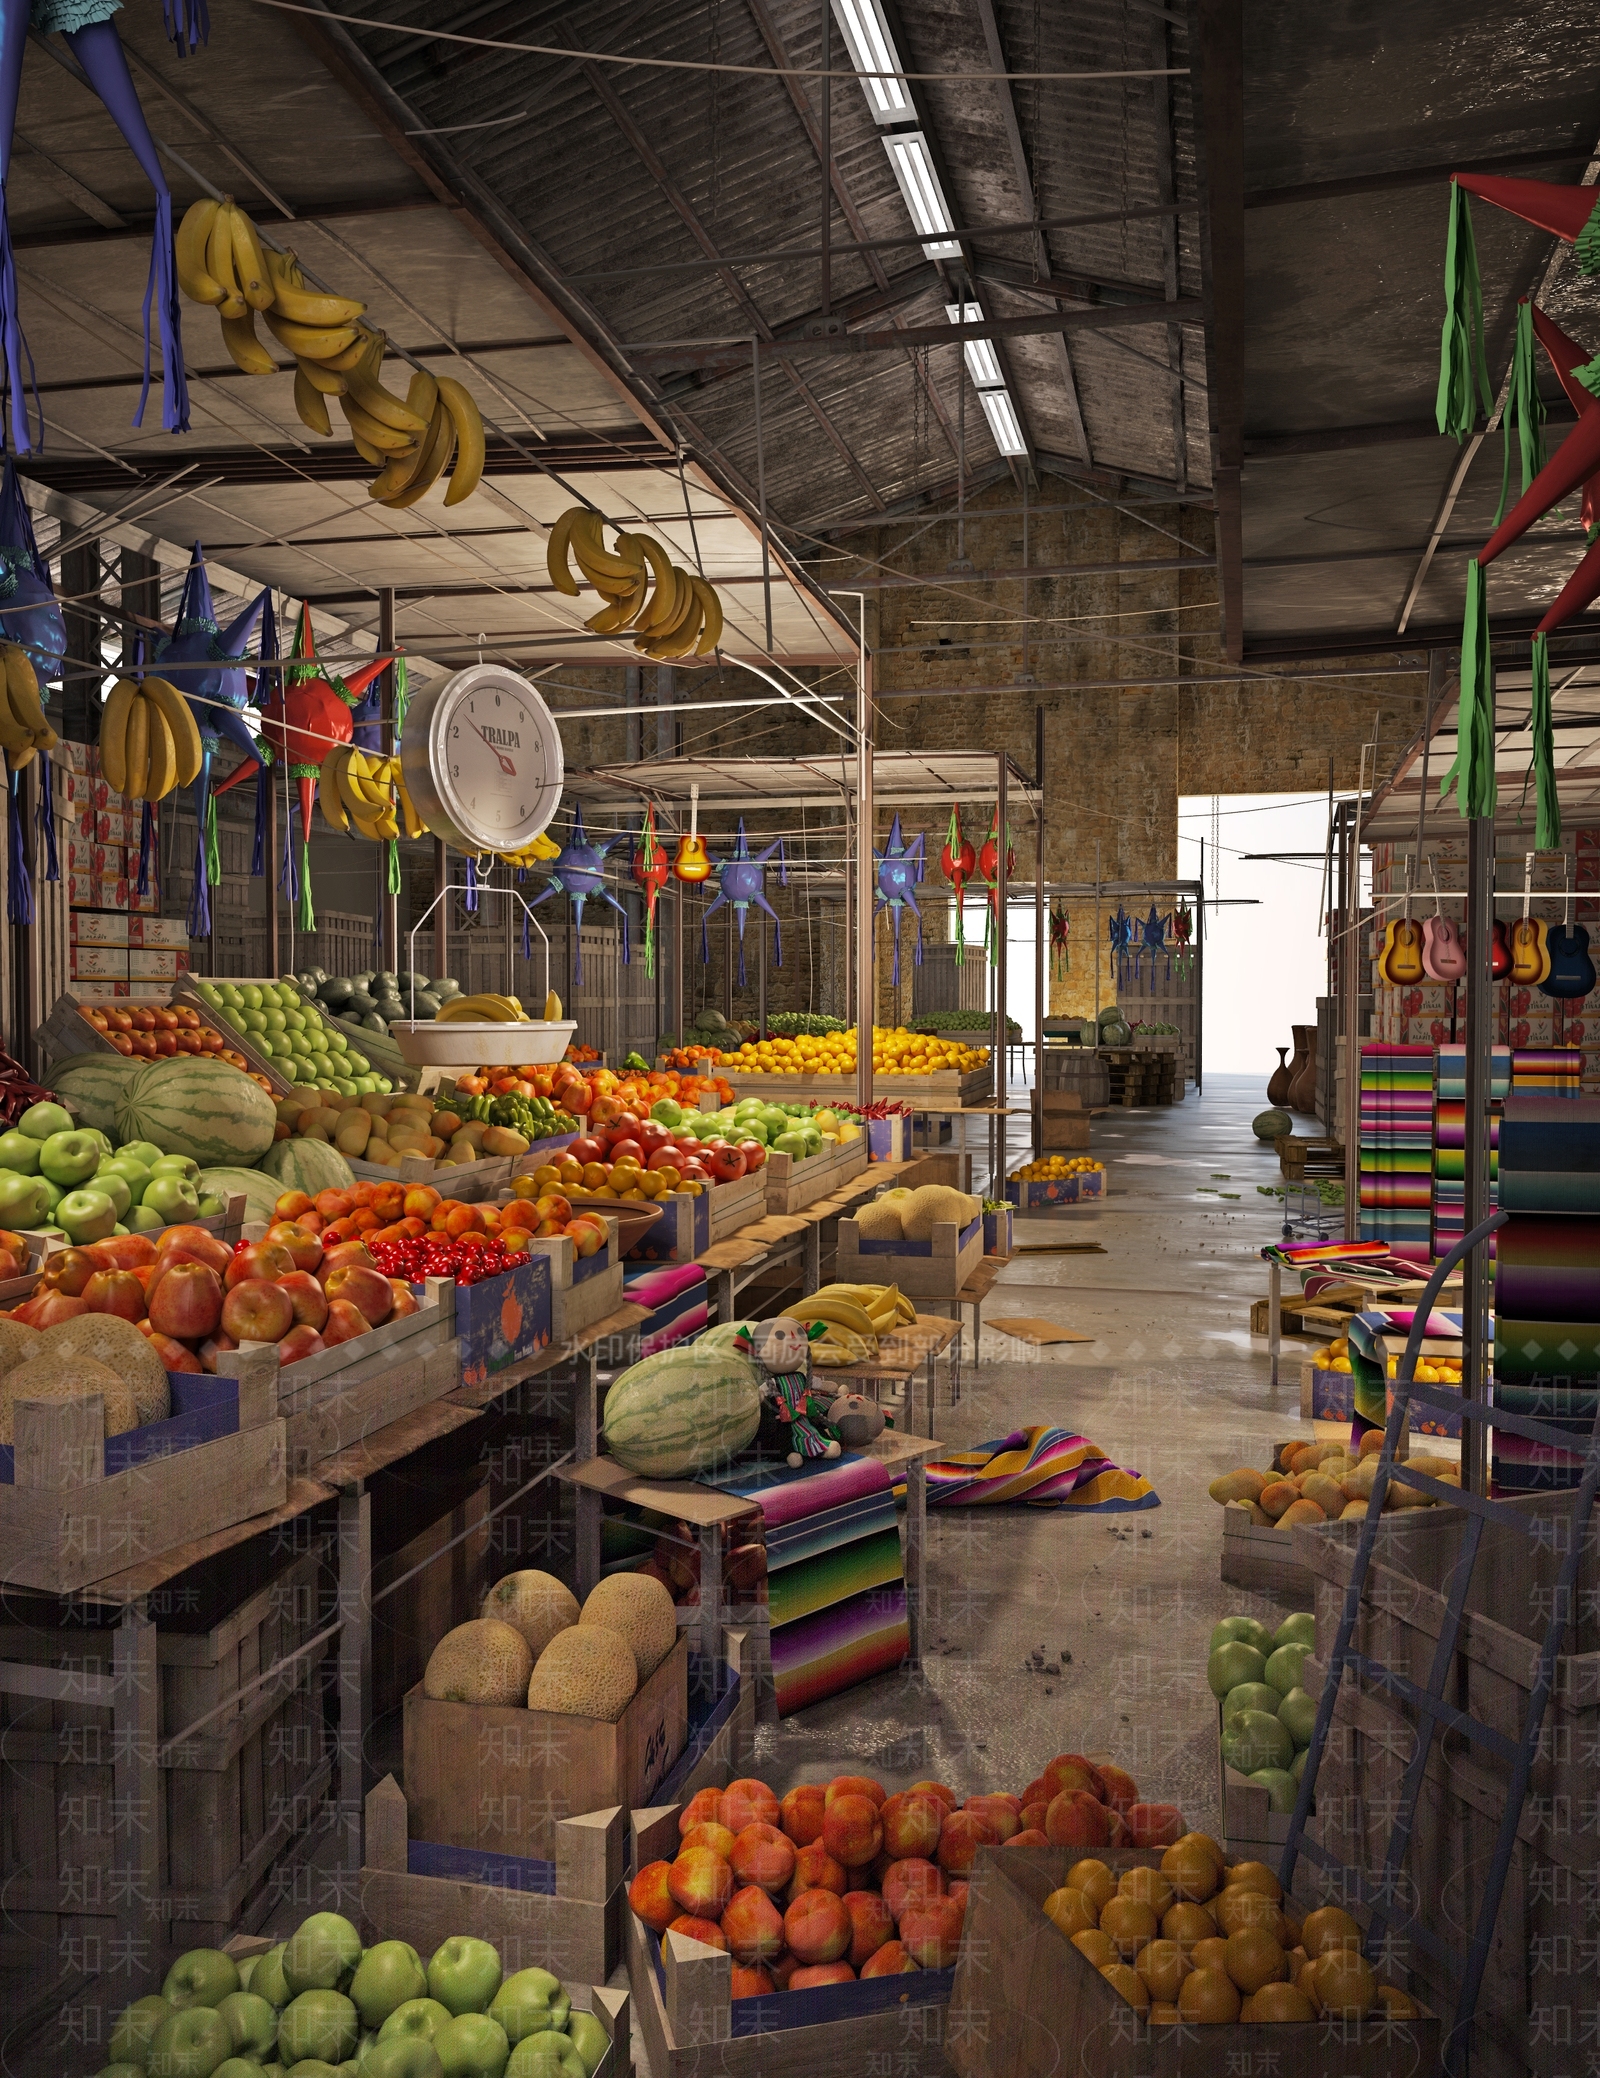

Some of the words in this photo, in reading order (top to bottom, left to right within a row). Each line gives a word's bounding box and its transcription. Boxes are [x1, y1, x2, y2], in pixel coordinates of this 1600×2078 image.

[470, 701, 475, 713] 1
[495, 695, 501, 707] 0
[519, 711, 525, 723] 9
[453, 726, 459, 739] 2
[481, 725, 521, 748] TRALPA
[534, 741, 540, 753] 8
[454, 765, 460, 778] 3
[470, 797, 476, 810] 4
[495, 810, 501, 822] 5
[520, 805, 525, 817] 6
